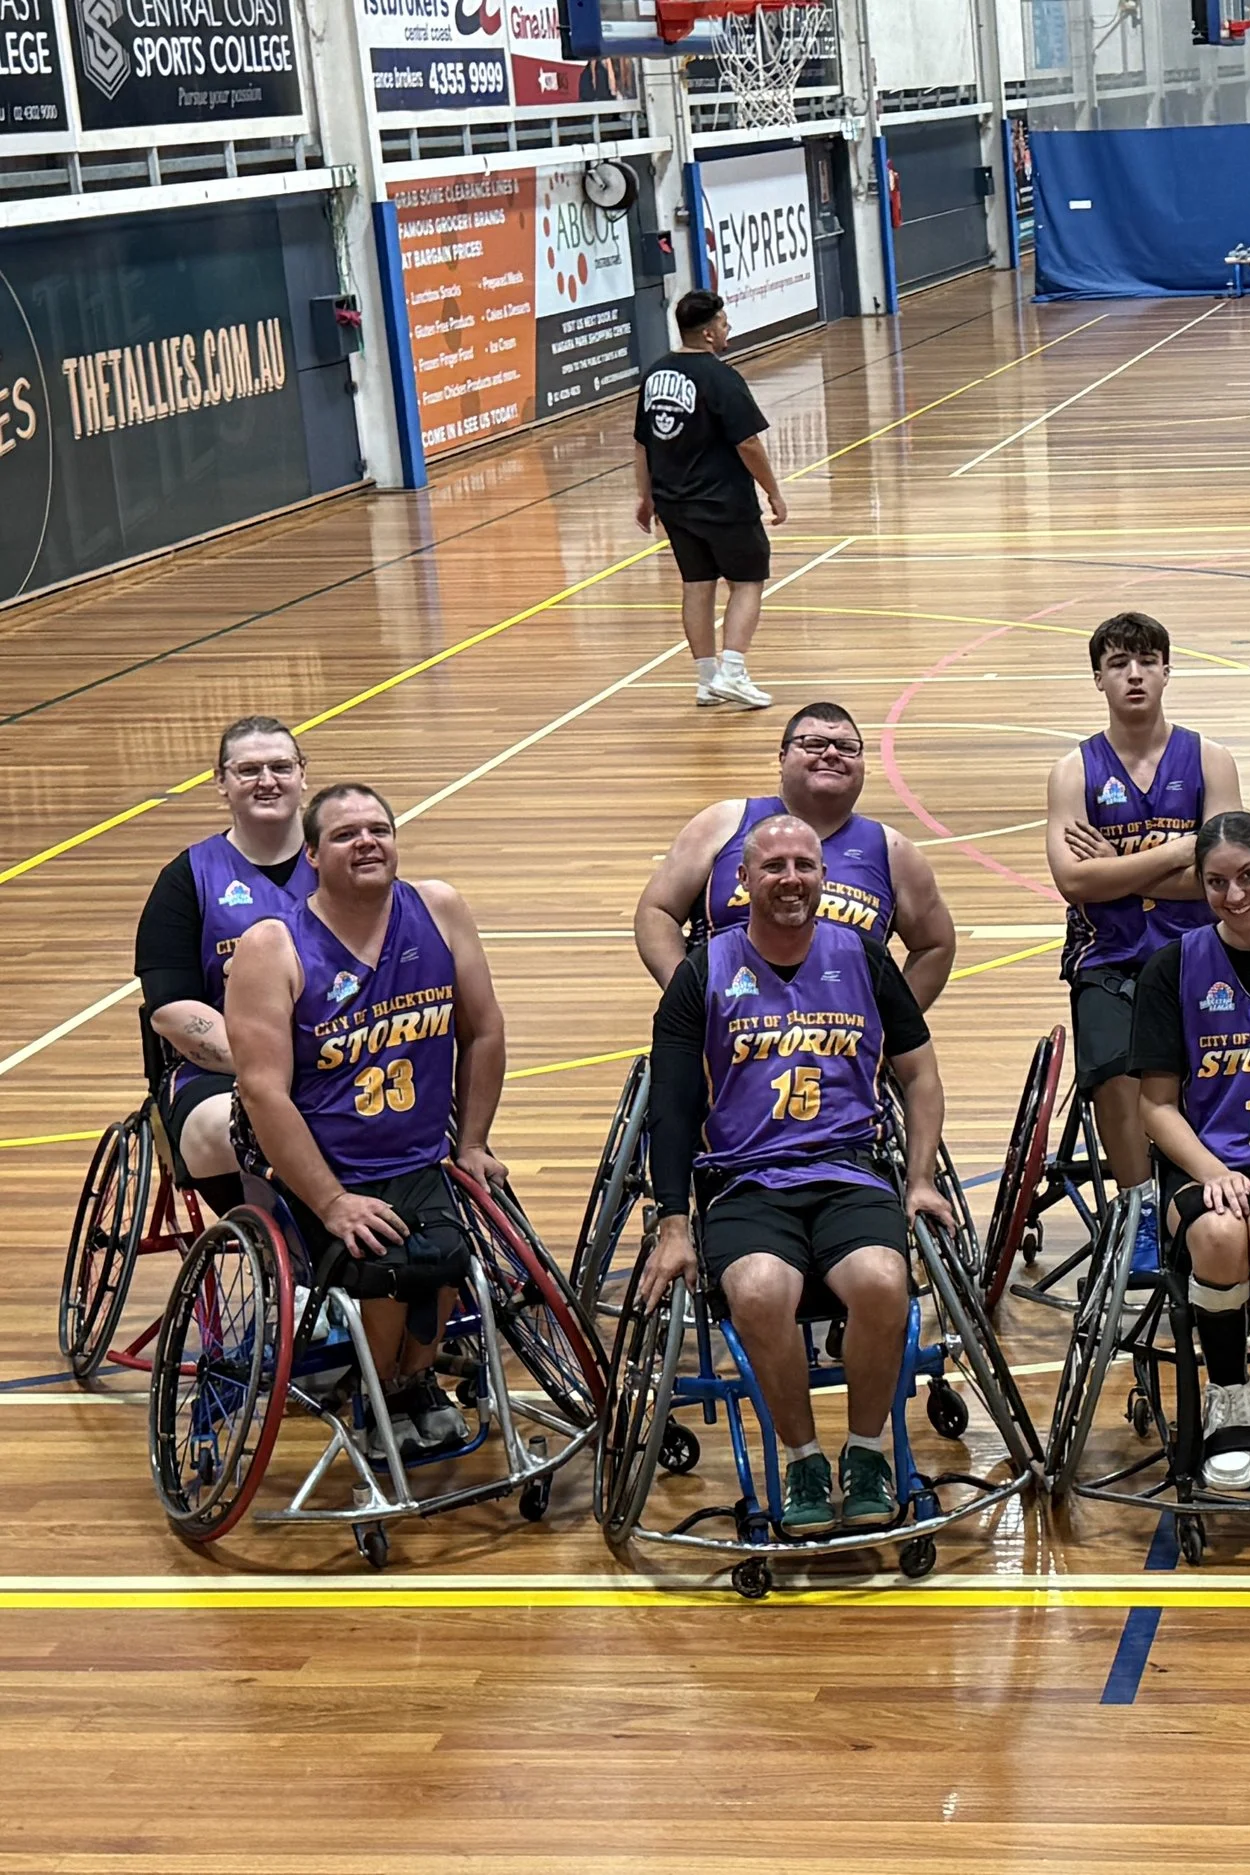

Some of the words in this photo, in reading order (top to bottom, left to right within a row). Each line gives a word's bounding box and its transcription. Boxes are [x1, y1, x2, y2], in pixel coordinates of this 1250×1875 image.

[127, 0, 222, 27] CENTRAL
[224, 0, 284, 26] COAST
[133, 36, 206, 77] SPORTS
[210, 35, 292, 73] COLLEGE
[429, 62, 465, 94] 4355
[468, 61, 503, 93] 9999
[398, 218, 434, 239] FAMOUS
[719, 203, 808, 281] EXPRESS
[1100, 824, 1123, 836] CITY
[1127, 822, 1142, 833] OF
[315, 1016, 349, 1038] CITY
[354, 1009, 368, 1024] OF
[372, 985, 453, 1018] BLACKTOWN
[729, 1016, 757, 1032] CITY
[764, 1015, 781, 1029] OF
[788, 1009, 865, 1028] BLACKTOWN
[317, 1003, 454, 1070] STORM
[732, 1026, 863, 1064] STORM
[1200, 1033, 1228, 1048] CITY
[1233, 1033, 1250, 1045] OF
[354, 1058, 415, 1117] 33
[771, 1066, 821, 1121] 15
